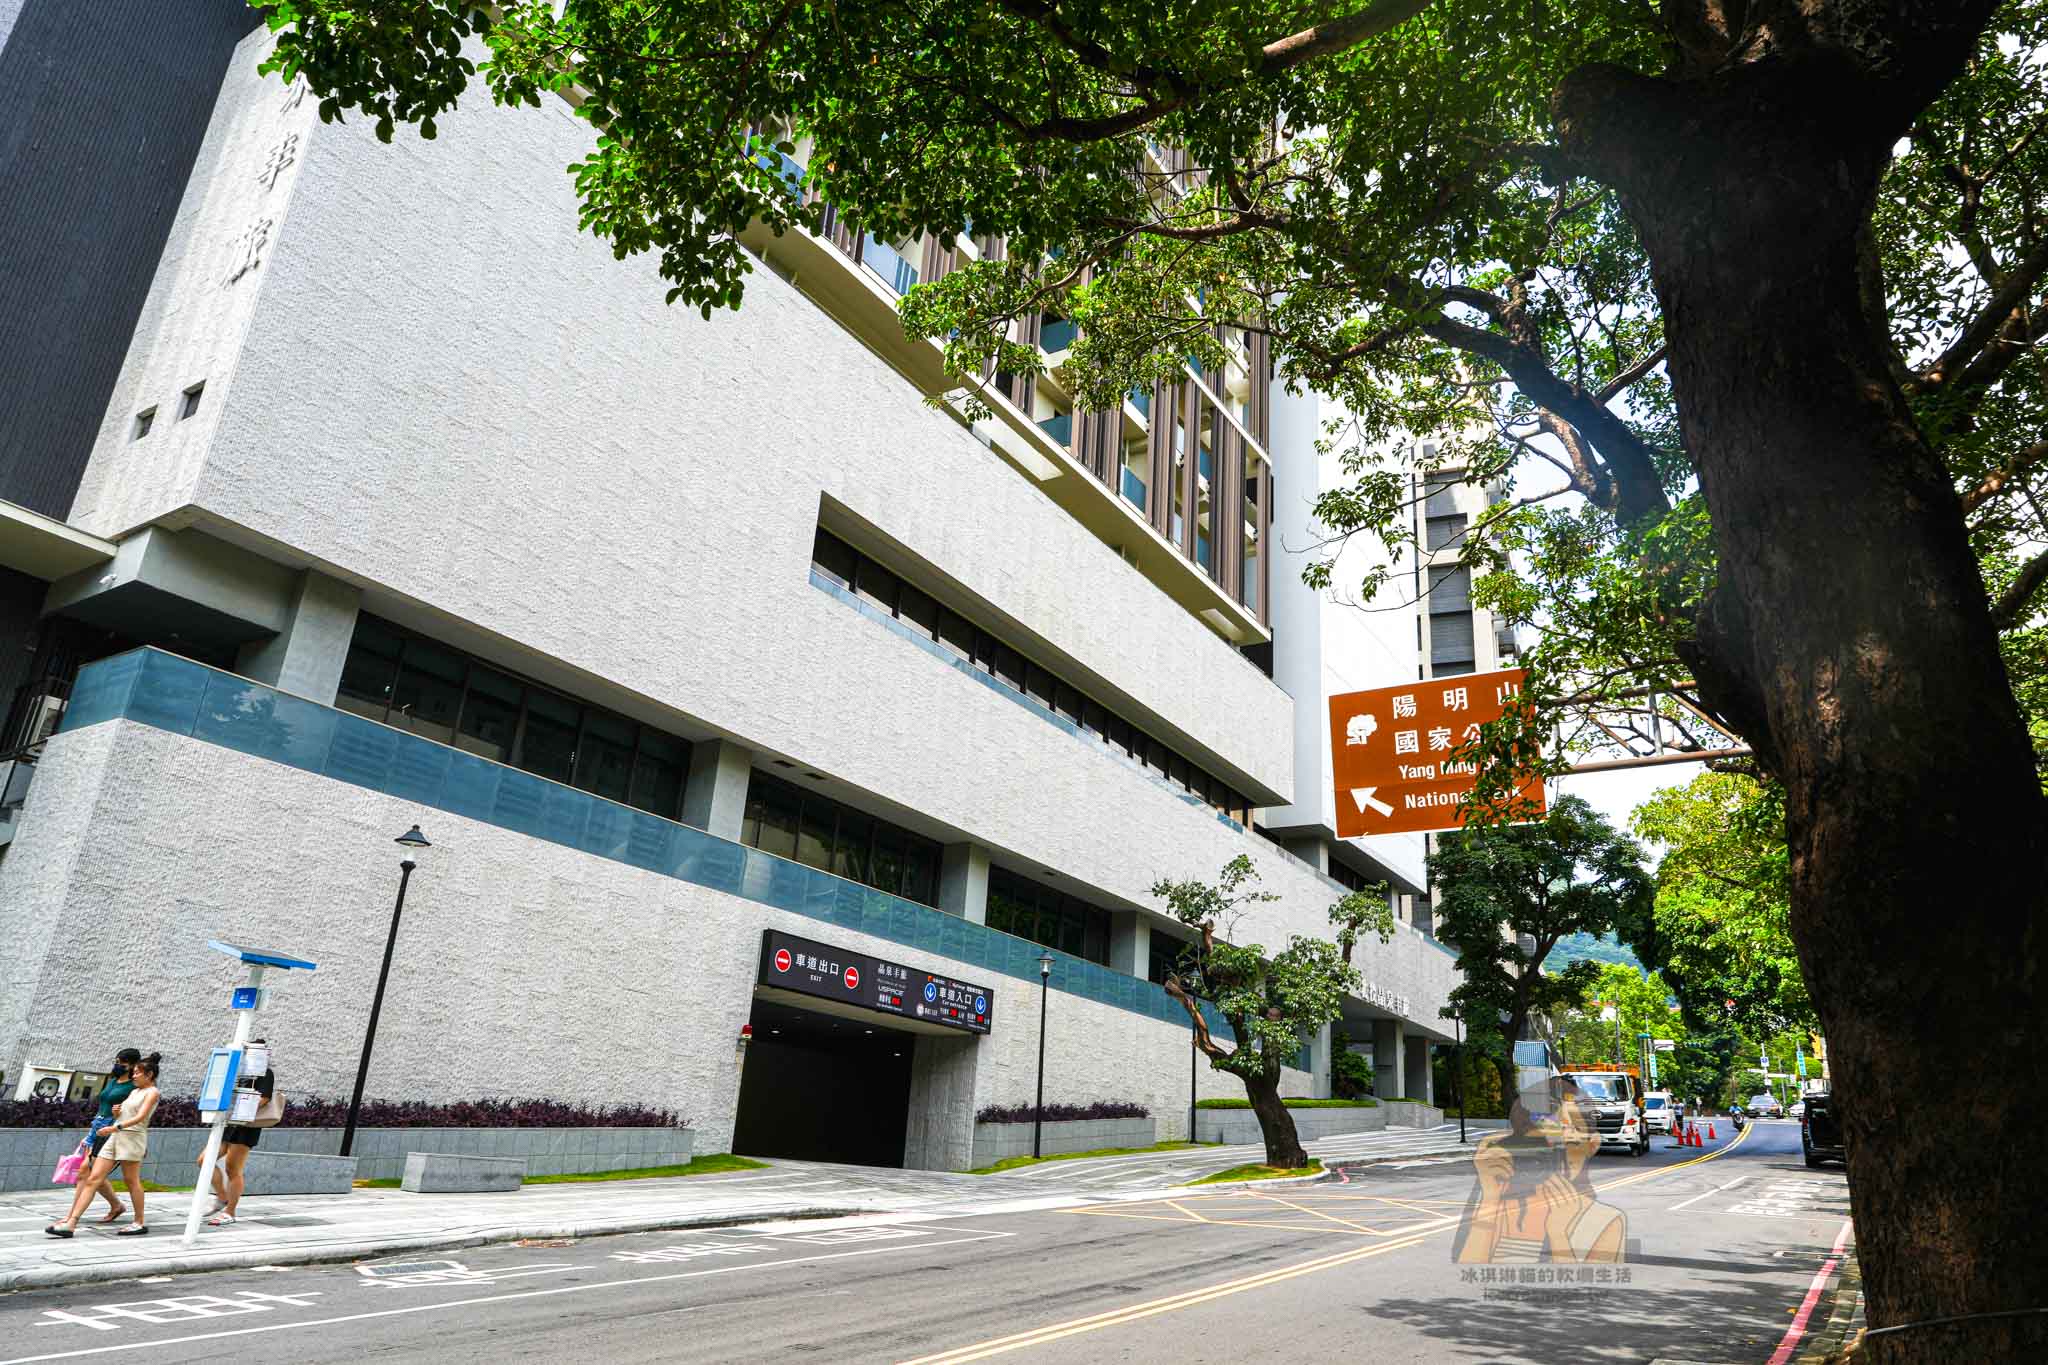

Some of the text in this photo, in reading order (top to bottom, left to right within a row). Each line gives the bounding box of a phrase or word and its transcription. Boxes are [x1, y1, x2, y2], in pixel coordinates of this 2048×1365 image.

[1392, 681, 1520, 719] 陽明山
[1394, 721, 1521, 755] 國家公
[1398, 764, 1435, 780] Yang
[1440, 759, 1477, 776] Ming
[796, 953, 840, 977] 車道出口
[809, 974, 823, 983] EXIT
[939, 988, 972, 1005] 車道入口
